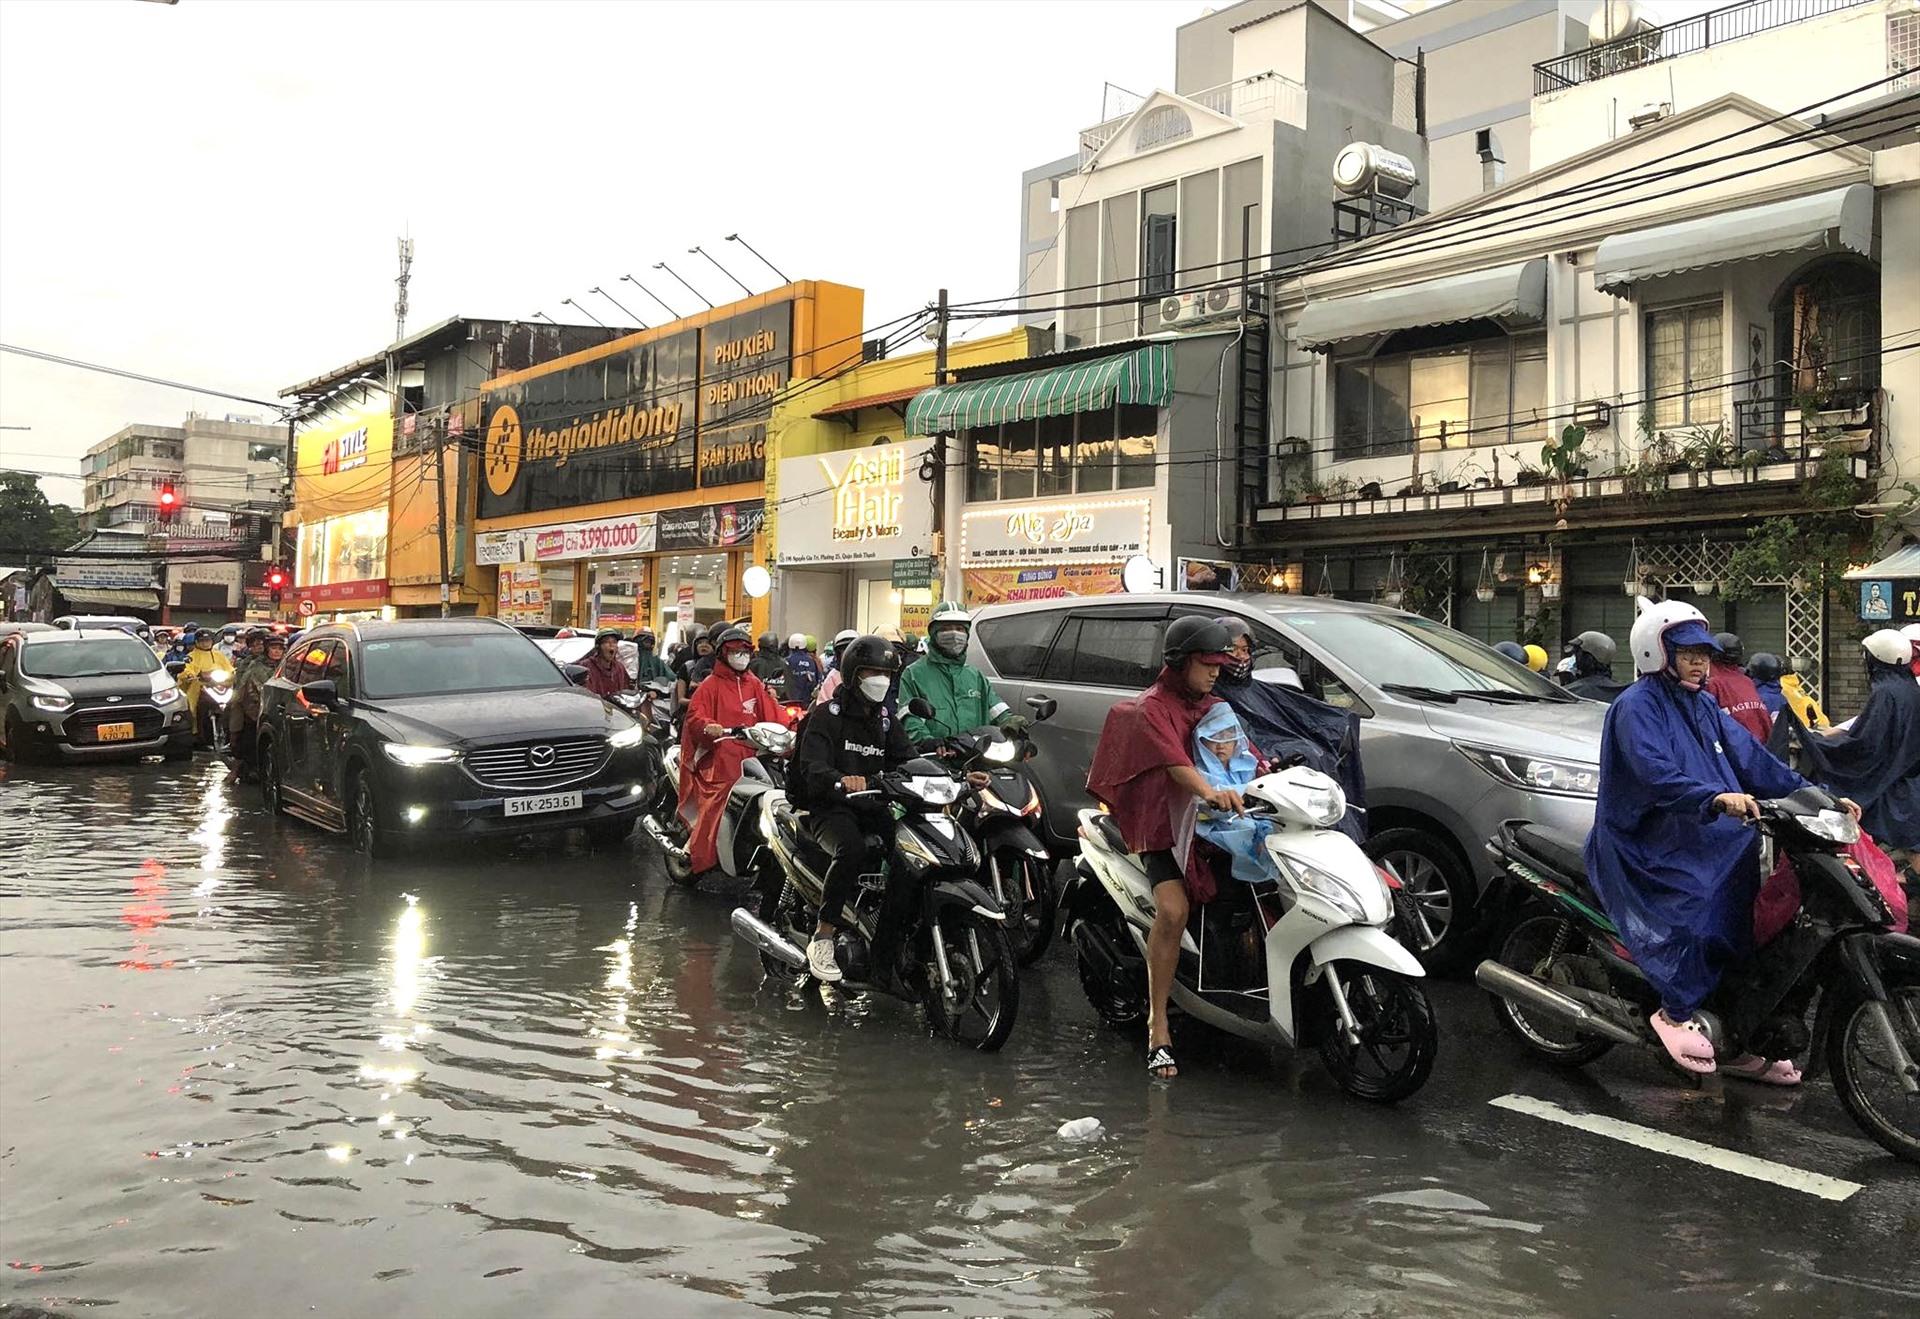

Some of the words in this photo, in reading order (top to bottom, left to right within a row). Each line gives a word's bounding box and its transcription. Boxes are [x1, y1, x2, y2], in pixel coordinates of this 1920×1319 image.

[715, 341, 743, 366] PHỤ
[743, 330, 776, 360] KIỆN
[709, 381, 739, 408] ĐIỆN
[740, 372, 781, 398] THOẠI
[526, 403, 682, 468] thegioididong
[701, 443, 726, 470] BÁN
[818, 447, 904, 518] Yoshii
[843, 486, 903, 526] Hair
[579, 522, 638, 550] 3.990.000
[833, 526, 865, 541] Beauty
[867, 525, 873, 538] &
[876, 524, 899, 537] More
[1048, 511, 1092, 540] Spa
[1007, 588, 1029, 601] KHAI
[1302, 908, 1328, 925] HONDA
